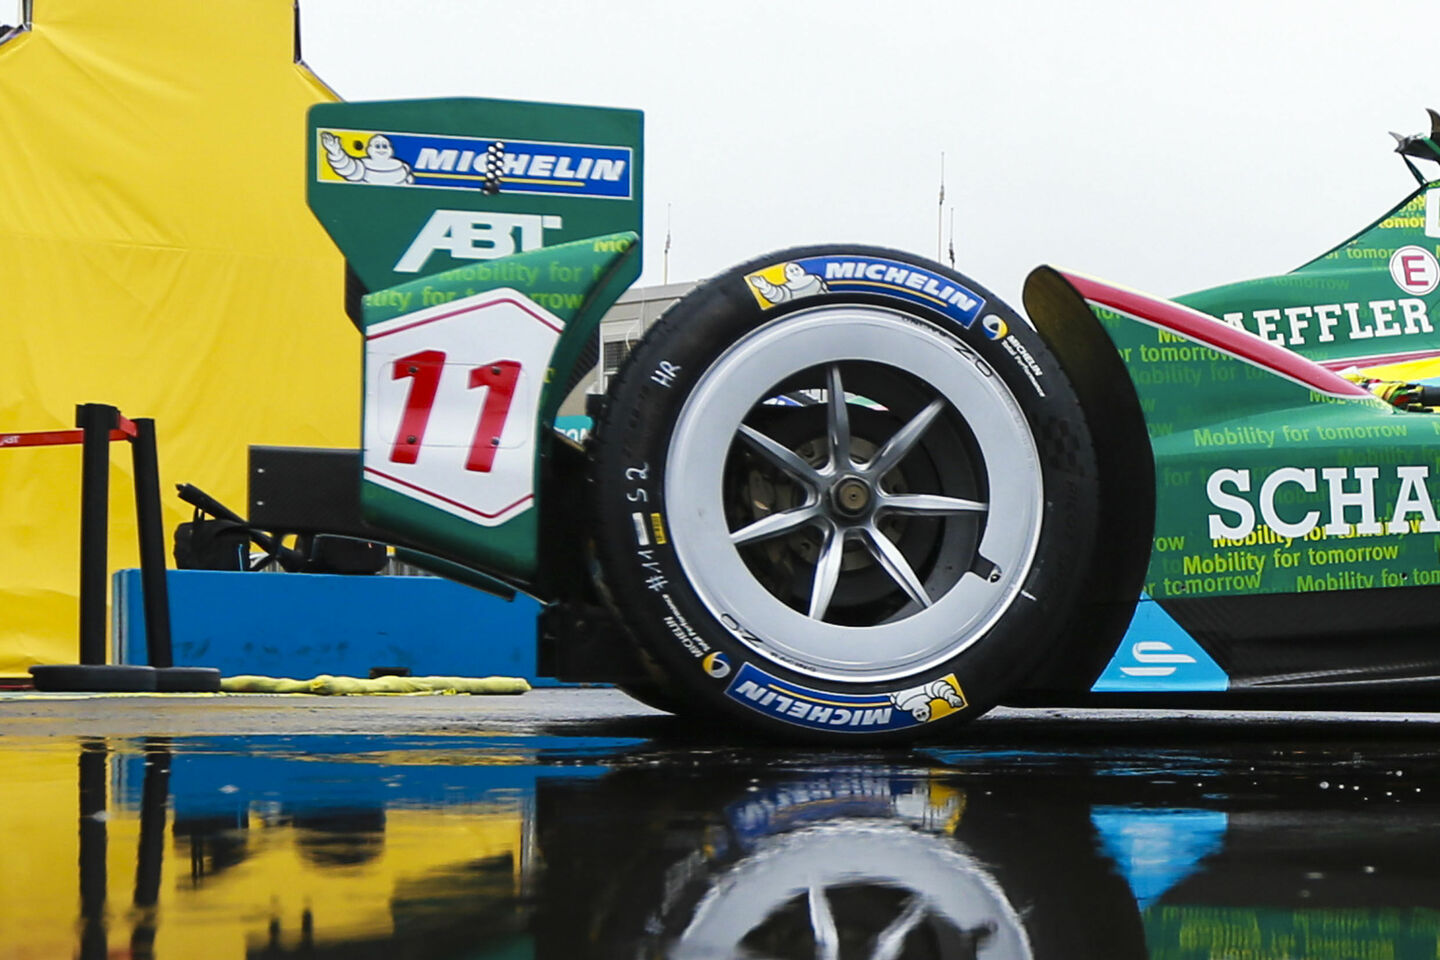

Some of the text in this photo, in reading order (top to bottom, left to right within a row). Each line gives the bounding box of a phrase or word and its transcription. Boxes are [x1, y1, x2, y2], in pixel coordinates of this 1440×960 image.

[414, 148, 626, 181] MICHELIN
[393, 209, 562, 273] ABT
[1401, 255, 1429, 286] E
[825, 262, 977, 313] MICHELIN
[651, 359, 682, 389] HR
[389, 350, 522, 473] 11
[1193, 427, 1276, 448] Mobility
[1282, 425, 1310, 442] for
[1316, 422, 1408, 441] tomorrow
[1183, 545, 1398, 576] Mobility for tomorrow
[735, 680, 893, 727] MICHELIN
